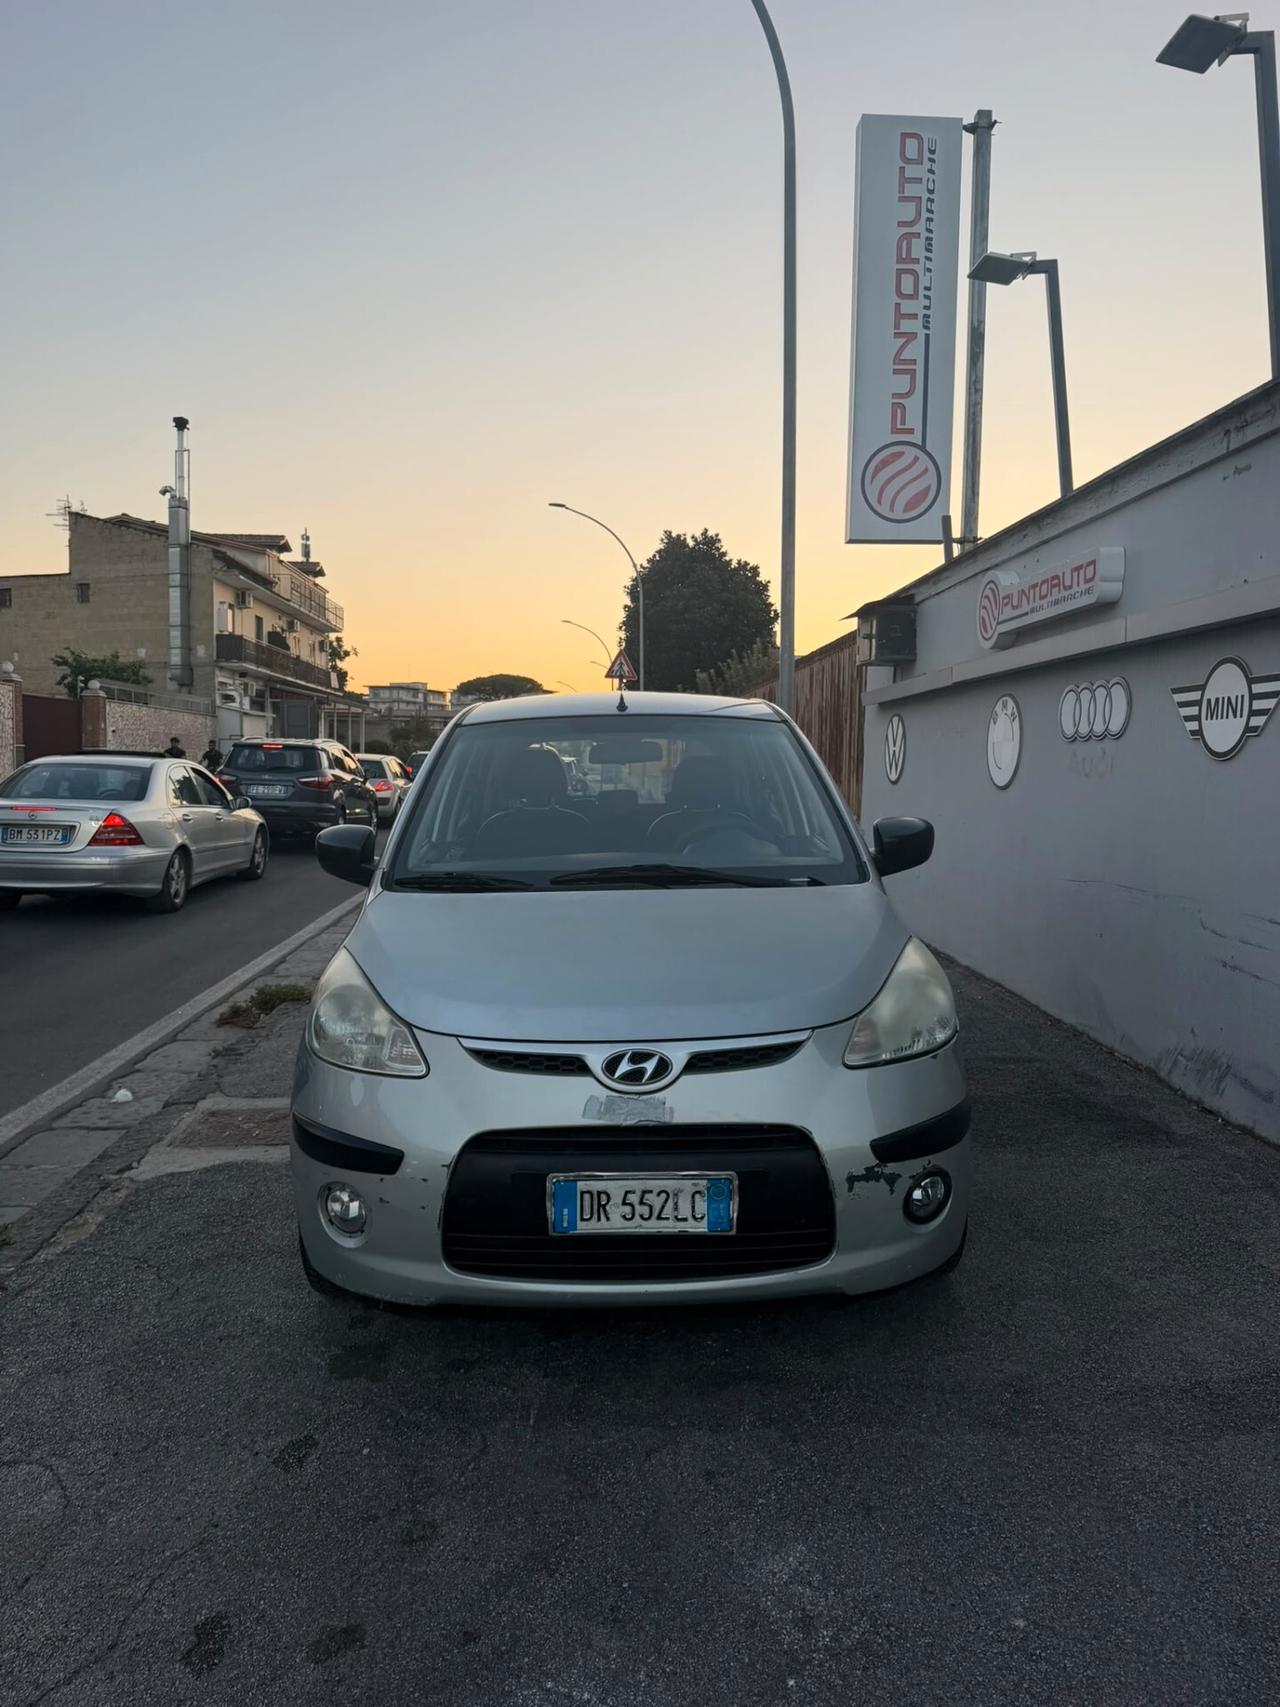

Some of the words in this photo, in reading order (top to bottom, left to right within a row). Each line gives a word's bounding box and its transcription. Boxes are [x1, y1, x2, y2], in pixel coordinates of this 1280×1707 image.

[922, 135, 938, 331] MULTIMARCHE
[890, 131, 925, 435] PUNTOAUTO
[1001, 558, 1097, 615] PUNTOAUTO
[990, 696, 1018, 719] BMW
[1205, 694, 1245, 721] MINI
[9, 828, 23, 840] BM
[26, 828, 61, 841] 531PZ
[579, 1189, 611, 1223] DR
[620, 1189, 706, 1224] 552LC
